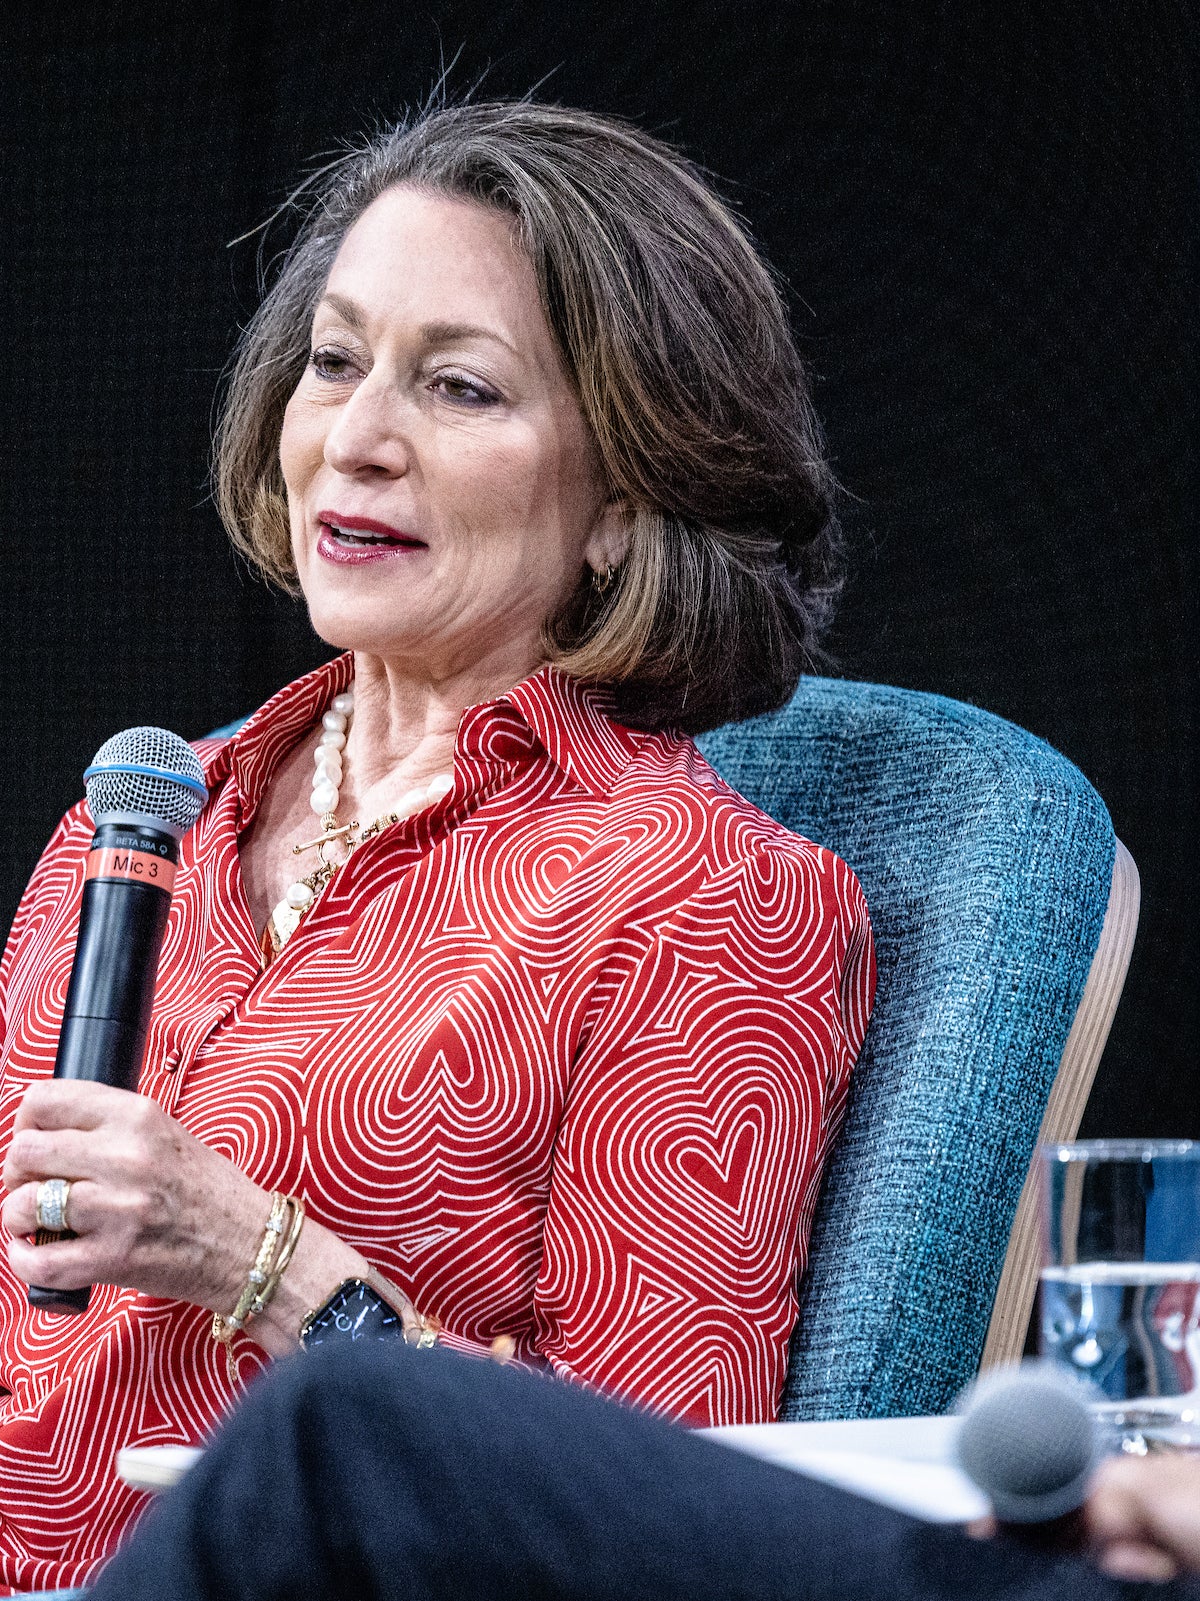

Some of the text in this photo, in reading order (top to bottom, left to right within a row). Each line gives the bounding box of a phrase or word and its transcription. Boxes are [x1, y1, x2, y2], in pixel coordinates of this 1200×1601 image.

[116, 837, 139, 847] BETA
[140, 840, 156, 851] 58A
[113, 855, 158, 878] Mic 3
